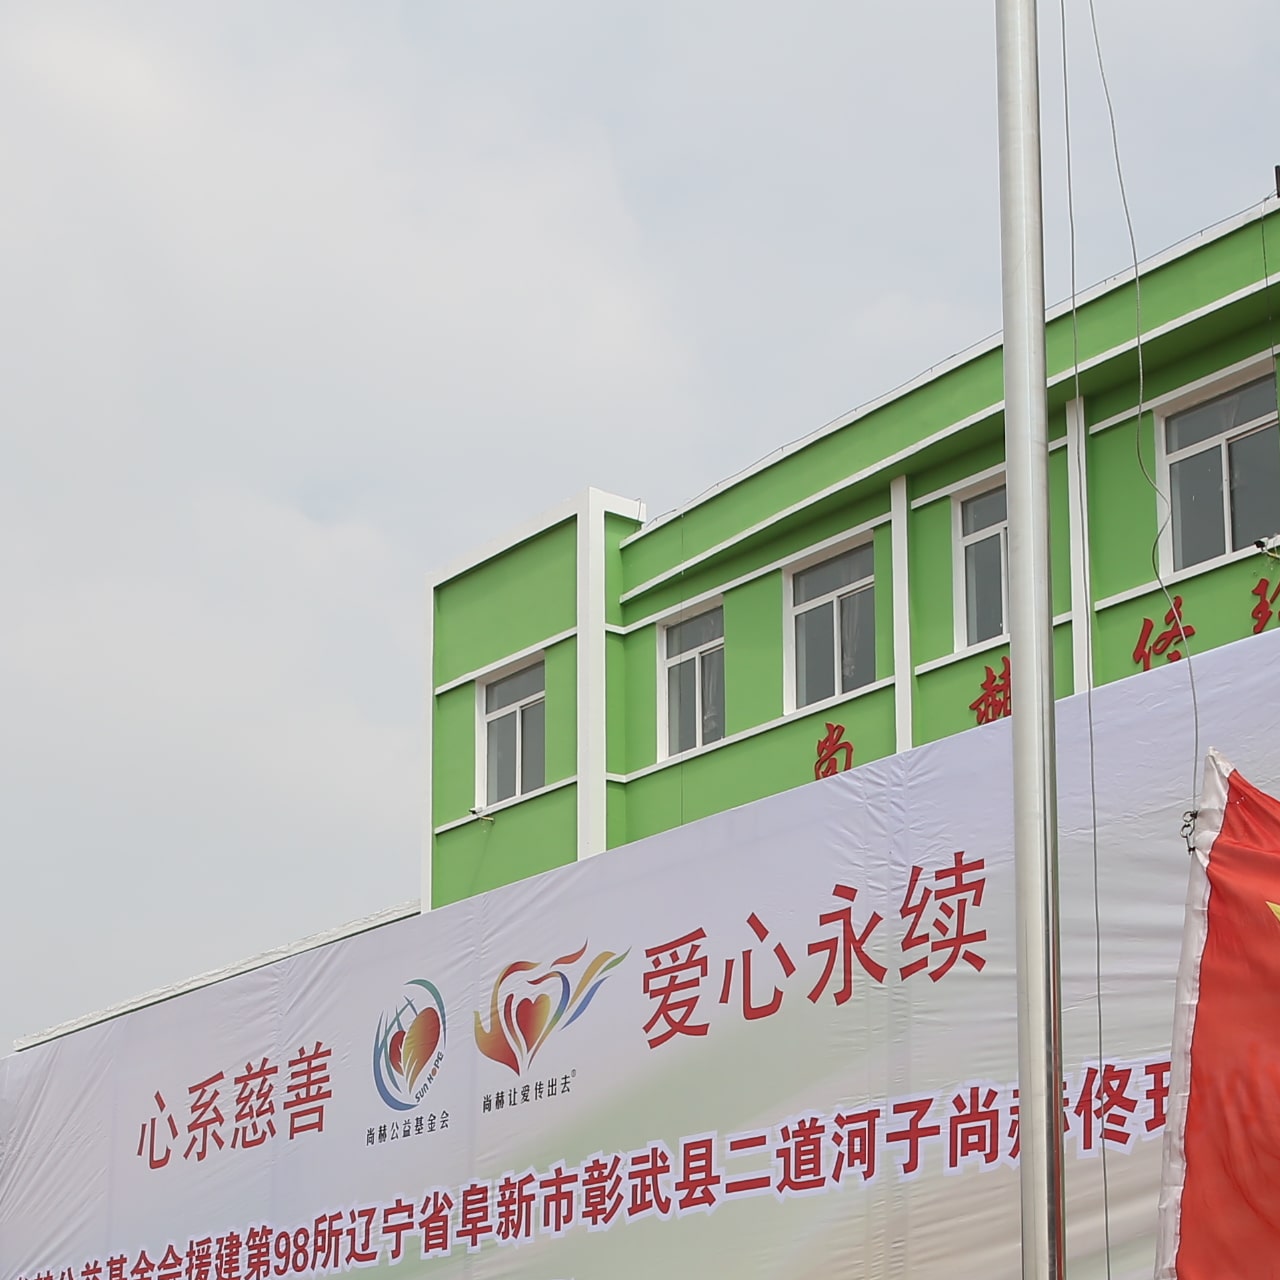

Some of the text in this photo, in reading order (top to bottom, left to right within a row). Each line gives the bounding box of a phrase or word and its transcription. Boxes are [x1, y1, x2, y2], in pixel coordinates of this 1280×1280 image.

[641, 850, 987, 1049] 爱心永续
[136, 1040, 333, 1171] 心系慈善
[365, 1109, 450, 1147] 尚赫公益基金会
